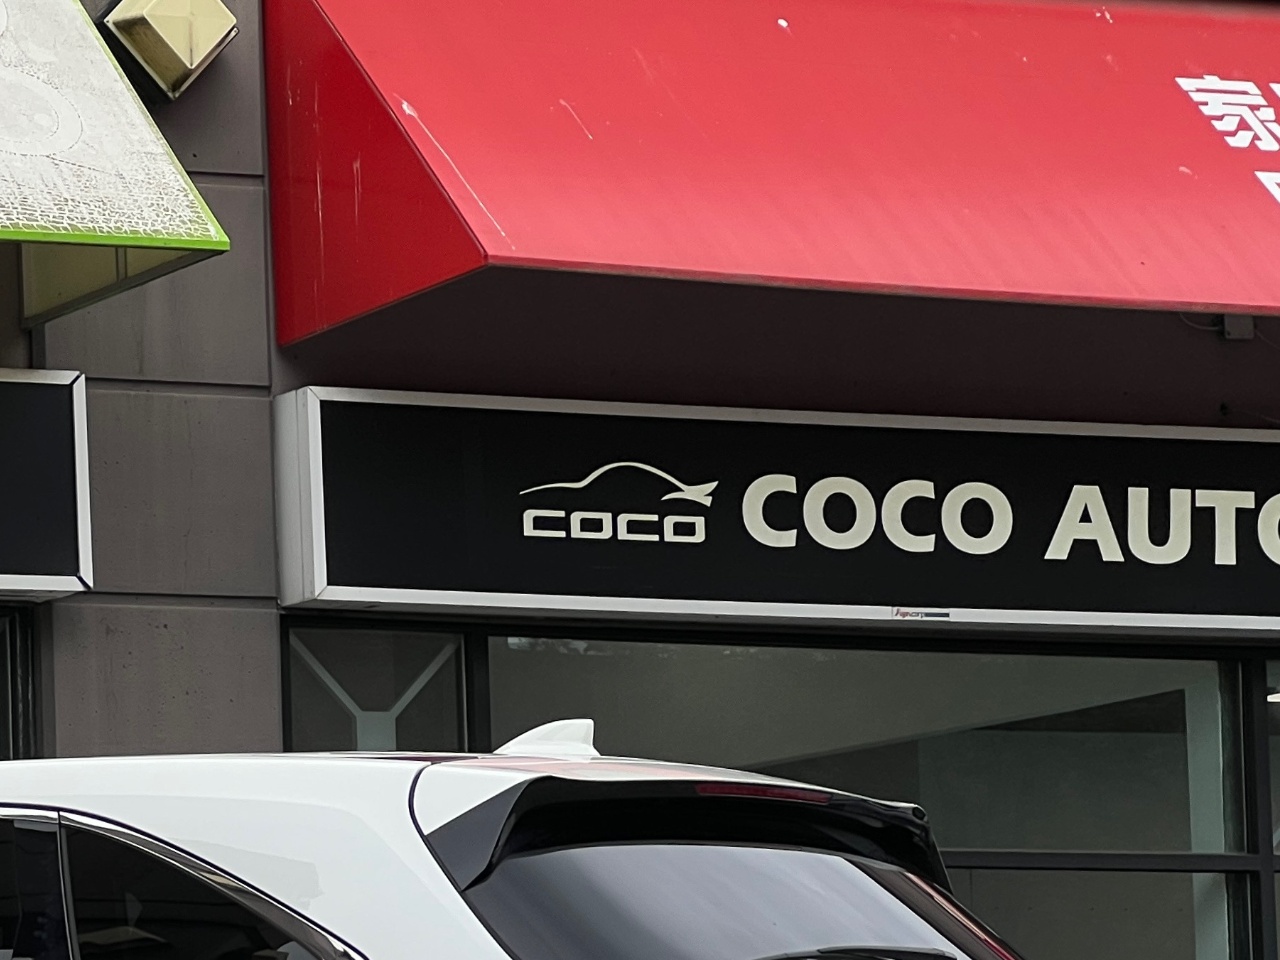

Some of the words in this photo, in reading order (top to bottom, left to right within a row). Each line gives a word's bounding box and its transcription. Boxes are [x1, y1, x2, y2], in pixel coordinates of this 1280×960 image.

[1174, 73, 1280, 152] 家
[521, 508, 707, 544] COCO
[741, 472, 1015, 556] COCO
